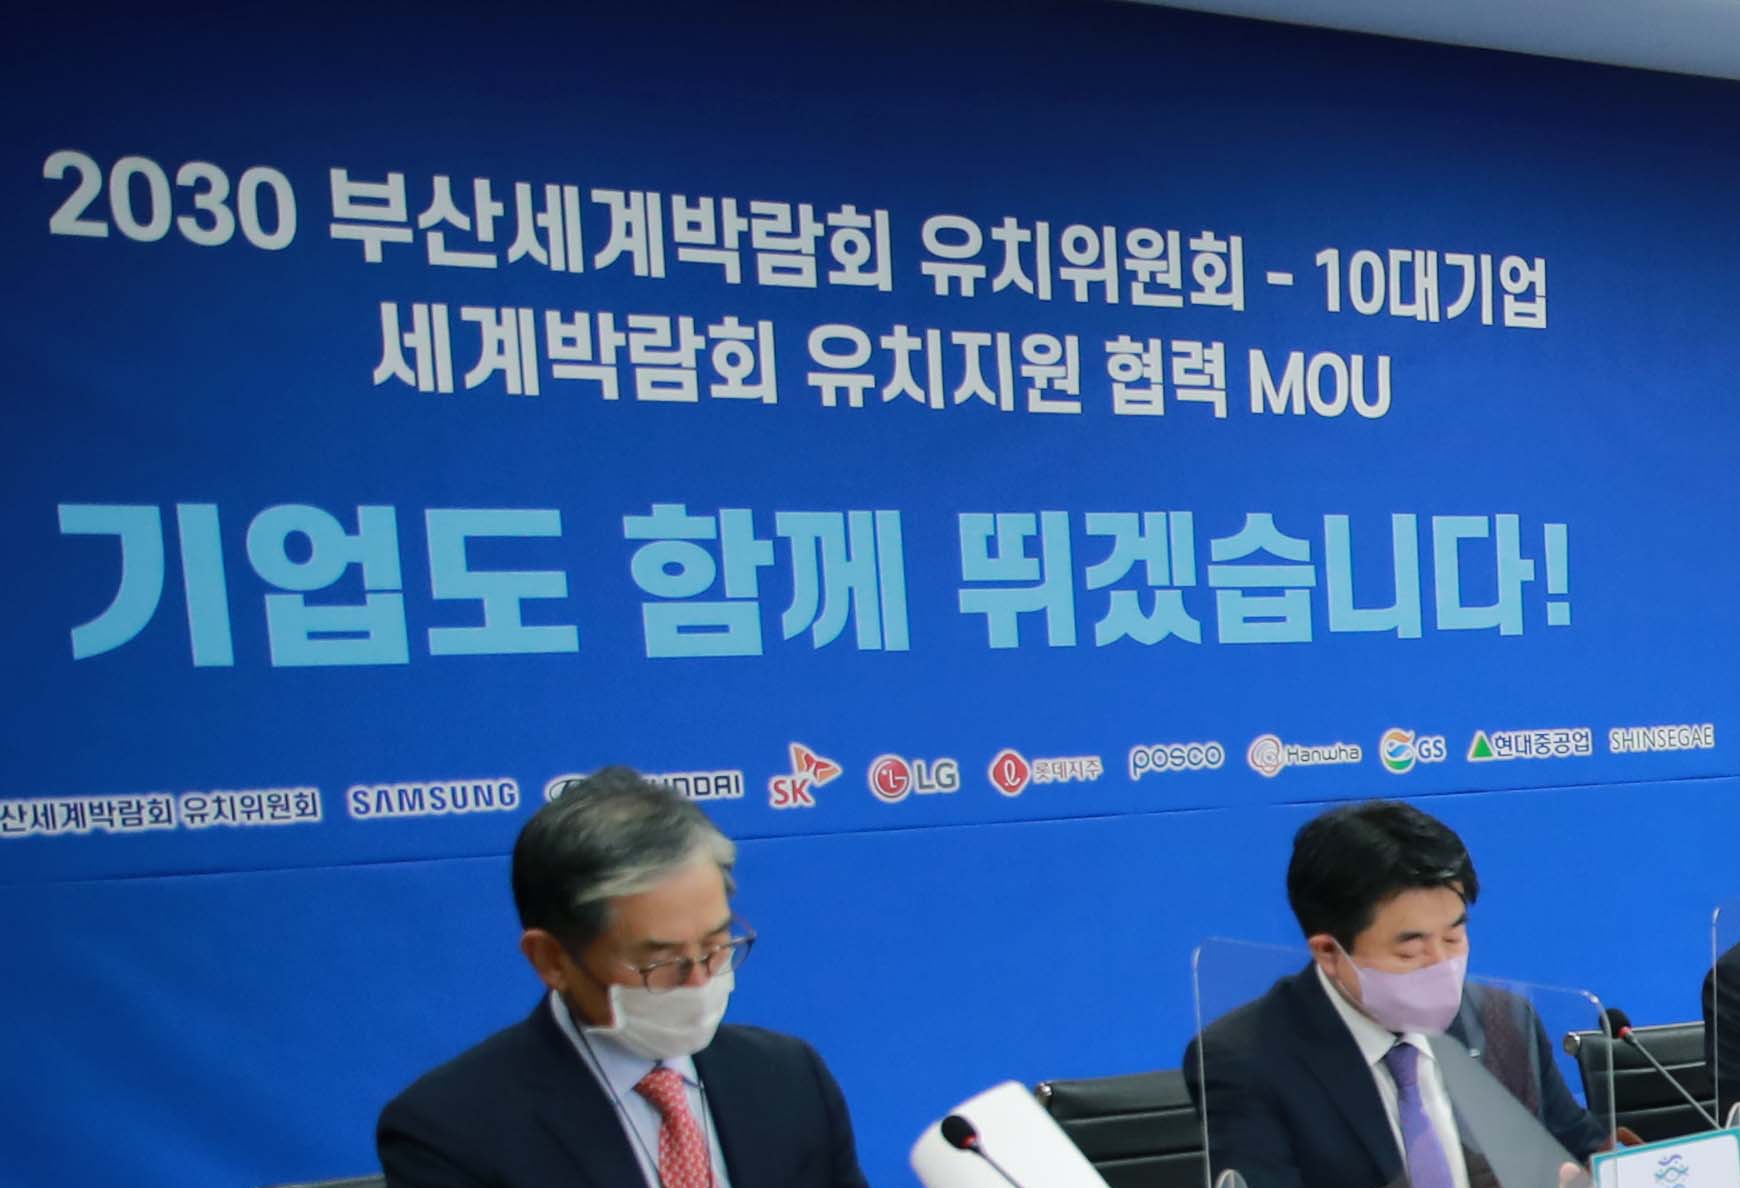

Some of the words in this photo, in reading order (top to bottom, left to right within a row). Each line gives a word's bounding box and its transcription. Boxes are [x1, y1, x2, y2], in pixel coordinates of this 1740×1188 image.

[42, 150, 297, 250] 2030
[329, 166, 893, 291] 부산세계박람회
[919, 214, 1246, 311] 유치위원회
[1316, 248, 1549, 329] 10대기업
[372, 302, 778, 404] 세계박람회
[807, 324, 1082, 415] 유치지원
[1105, 335, 1227, 419] 협력
[1249, 351, 1391, 419] MOU
[56, 503, 580, 667] 기업도
[622, 503, 910, 660] 함께
[957, 509, 1573, 647] 뛰겠습니다!
[1417, 736, 1445, 760] GS
[1494, 730, 1592, 758] 현대중공업
[1610, 725, 1715, 751] SHINSEGAE
[1286, 744, 1361, 764] Hanwha
[772, 776, 811, 805] SK
[914, 760, 957, 791] LG
[184, 791, 319, 826] 유치위원회
[352, 783, 518, 816] SAMSUNG
